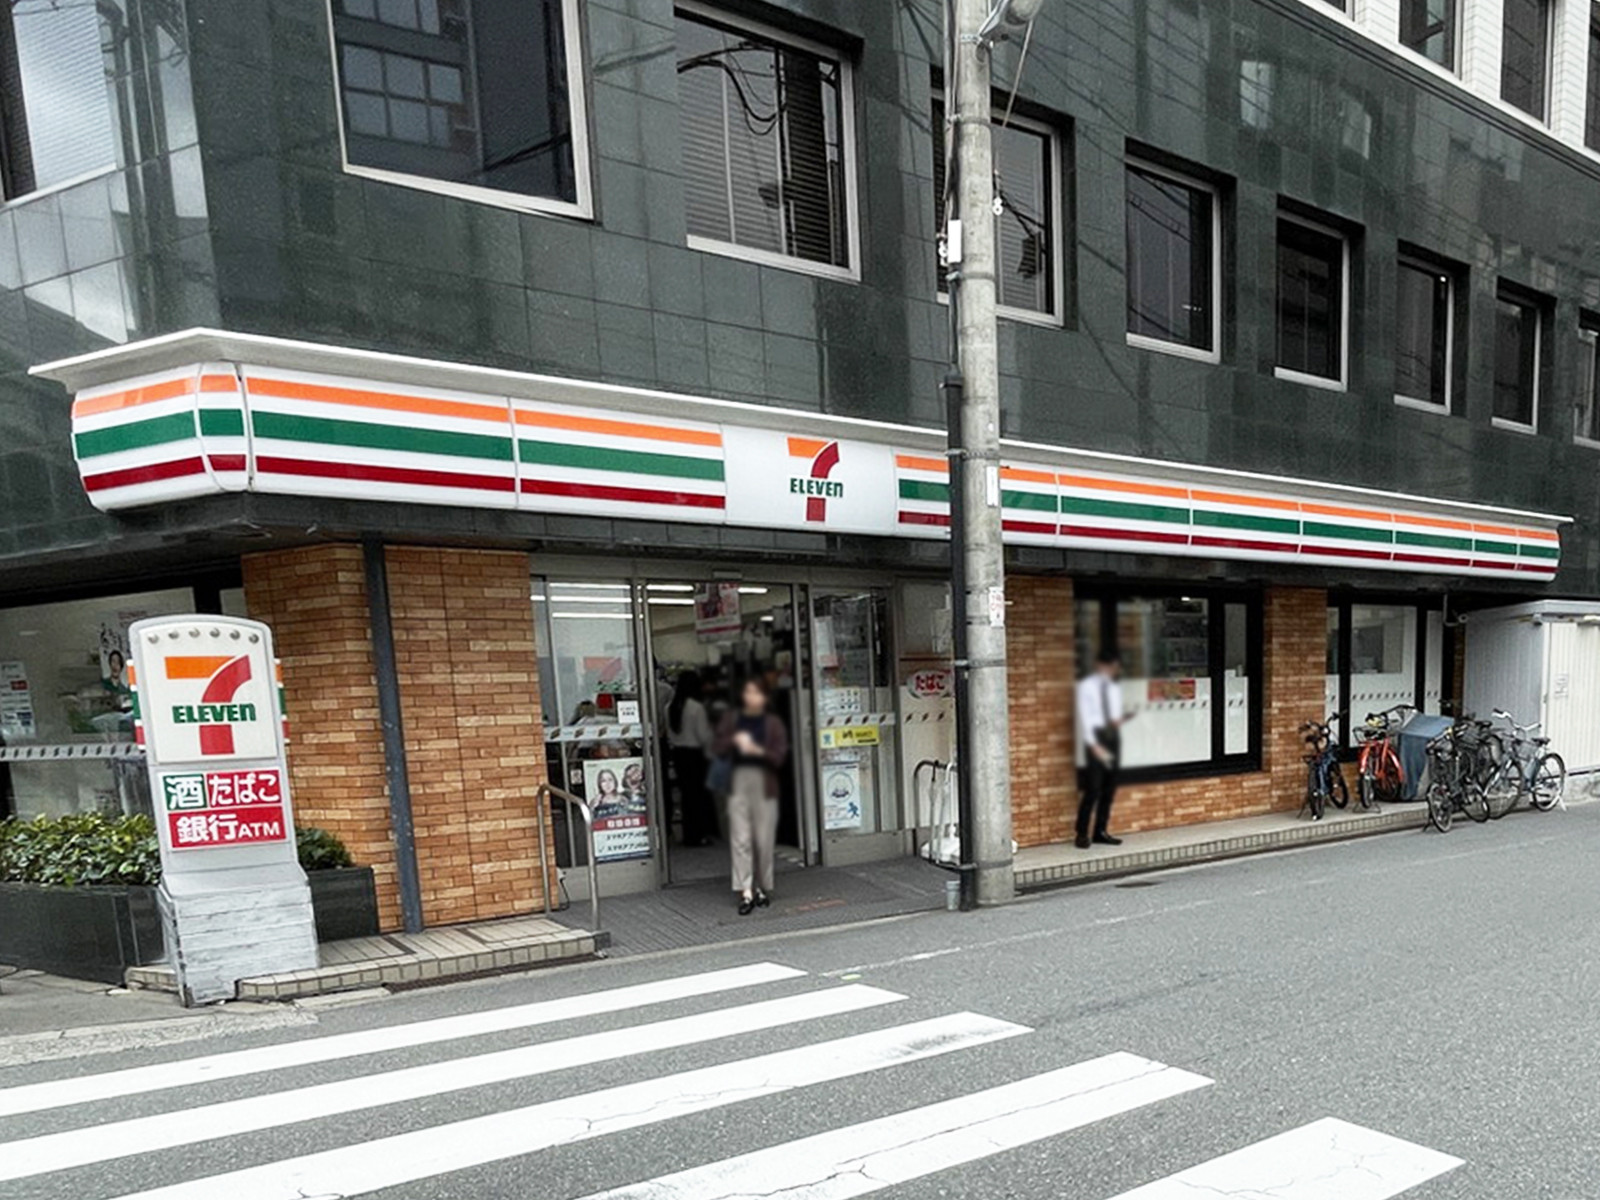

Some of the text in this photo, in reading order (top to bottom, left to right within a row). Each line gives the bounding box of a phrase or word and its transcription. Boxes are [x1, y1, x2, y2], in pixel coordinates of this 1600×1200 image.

[787, 437, 840, 522] 7
[915, 674, 945, 691] たばこ
[164, 654, 252, 755] 7
[166, 773, 280, 809] 酒 たばこ
[176, 813, 281, 844] 銀行ATM
